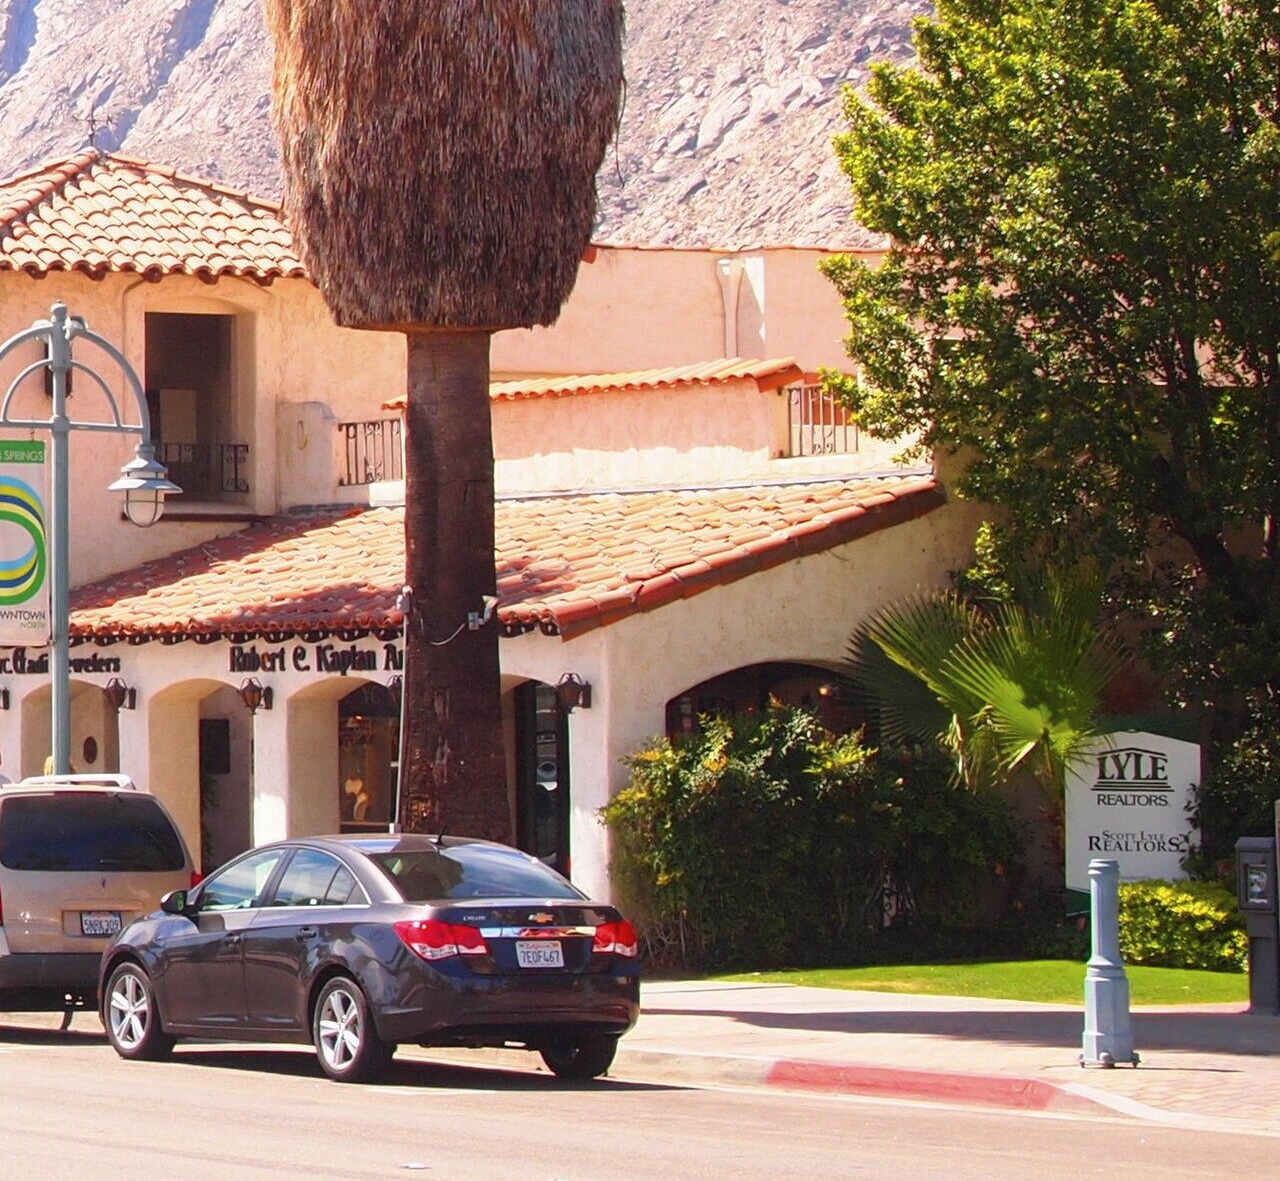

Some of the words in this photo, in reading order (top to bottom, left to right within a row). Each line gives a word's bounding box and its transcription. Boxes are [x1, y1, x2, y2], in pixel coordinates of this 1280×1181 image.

[4, 451, 44, 461] SPRINGS
[229, 644, 287, 673] Robert
[1096, 753, 1168, 780] LYLE
[1096, 794, 1169, 807] REALTORS
[1087, 835, 1181, 853] REALTORS
